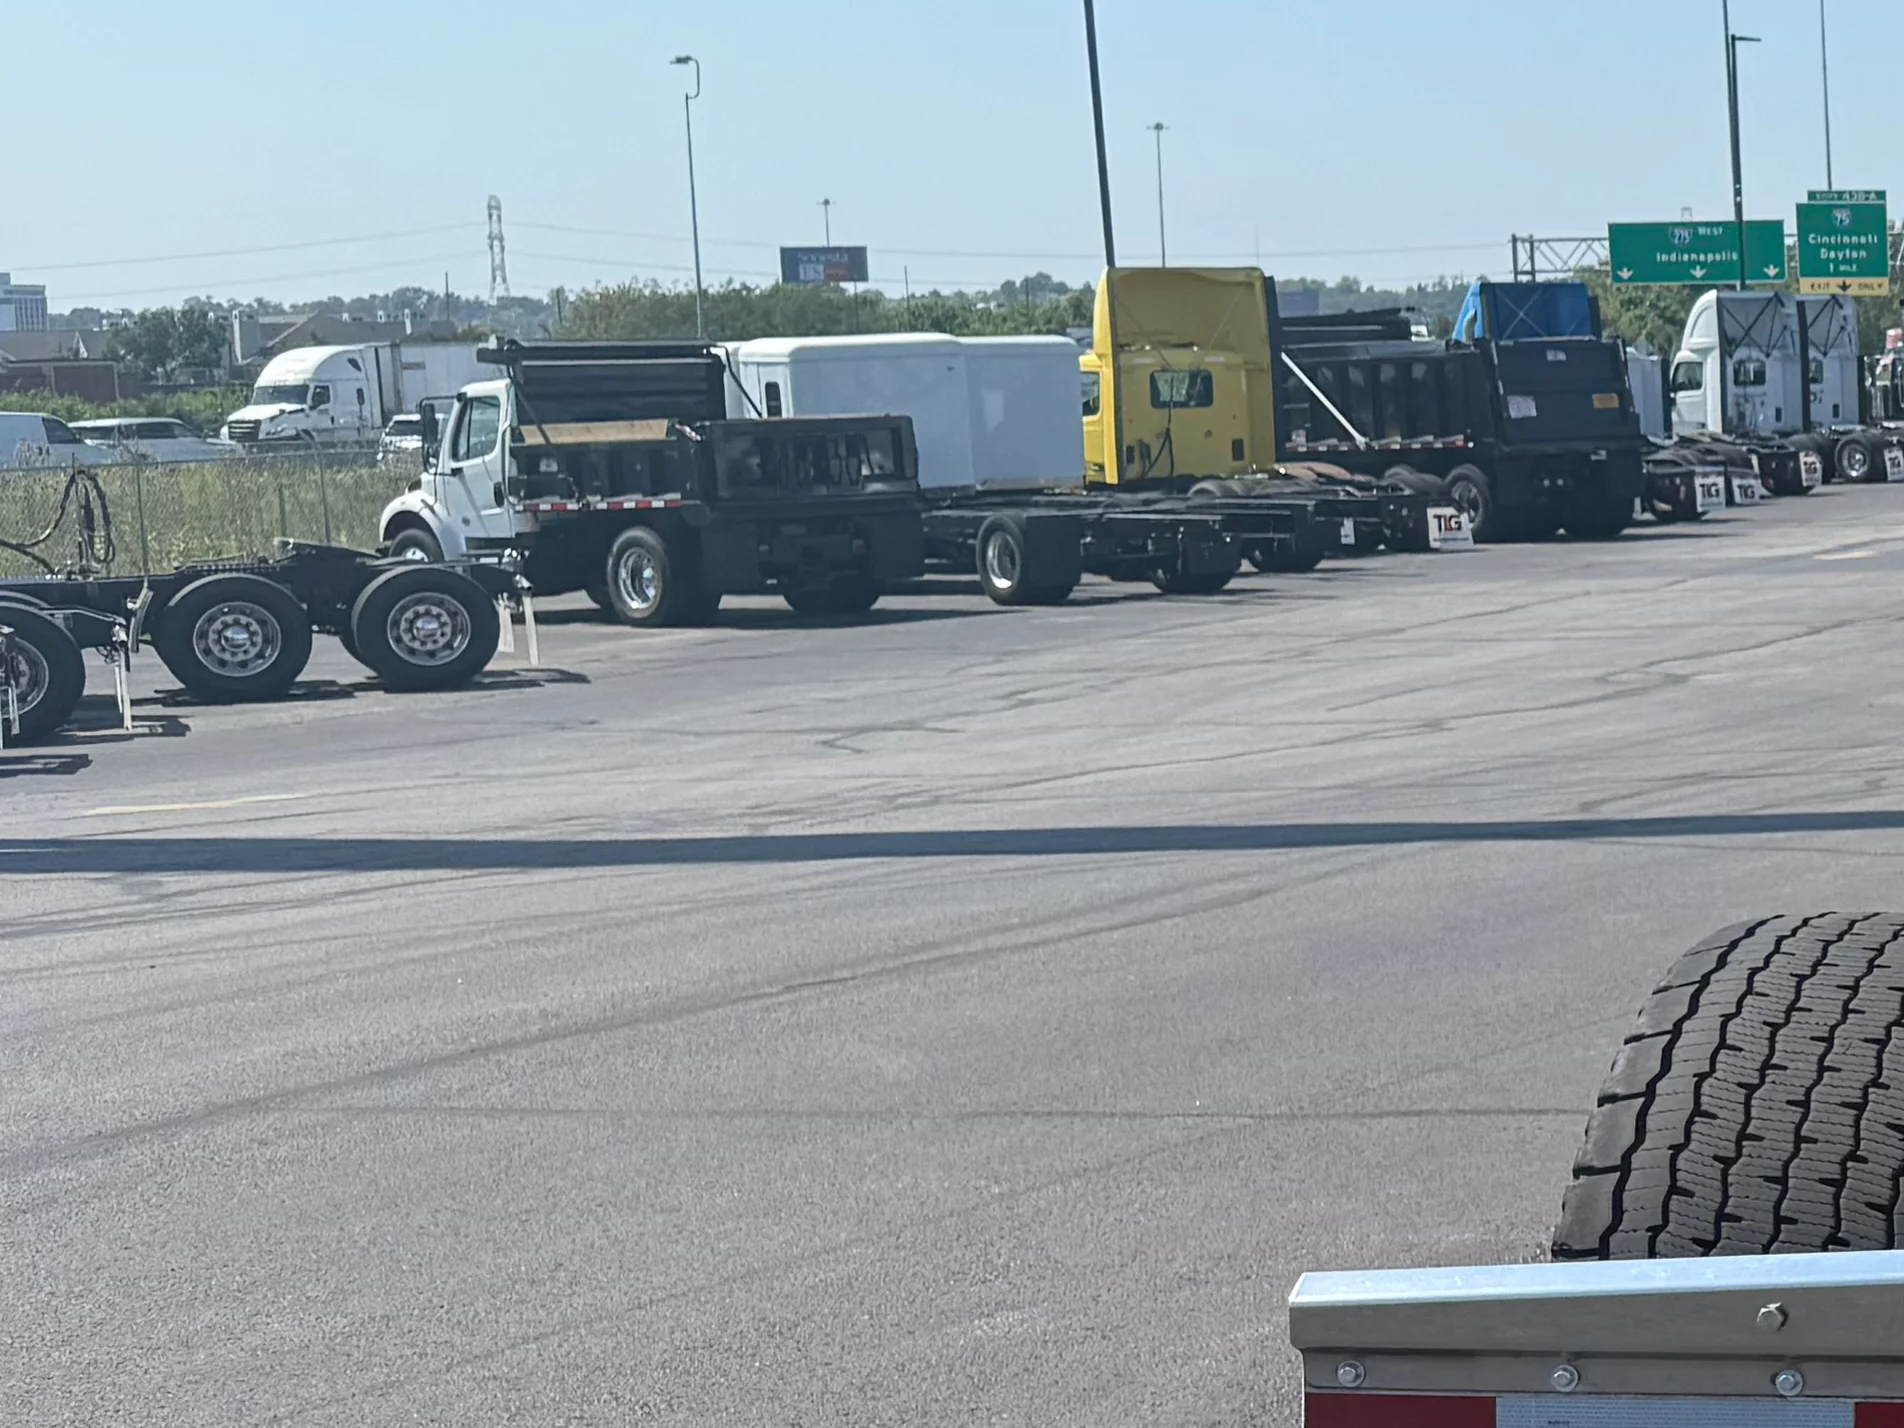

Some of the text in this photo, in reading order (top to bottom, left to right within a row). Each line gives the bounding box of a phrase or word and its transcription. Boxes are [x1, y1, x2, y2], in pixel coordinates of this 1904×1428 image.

[1808, 234, 1877, 245] Cincinnati
[1656, 251, 1738, 263] Indianapolis
[1820, 248, 1867, 260] Dayton
[1811, 283, 1830, 291] EXIT
[1433, 514, 1462, 533] TLG
